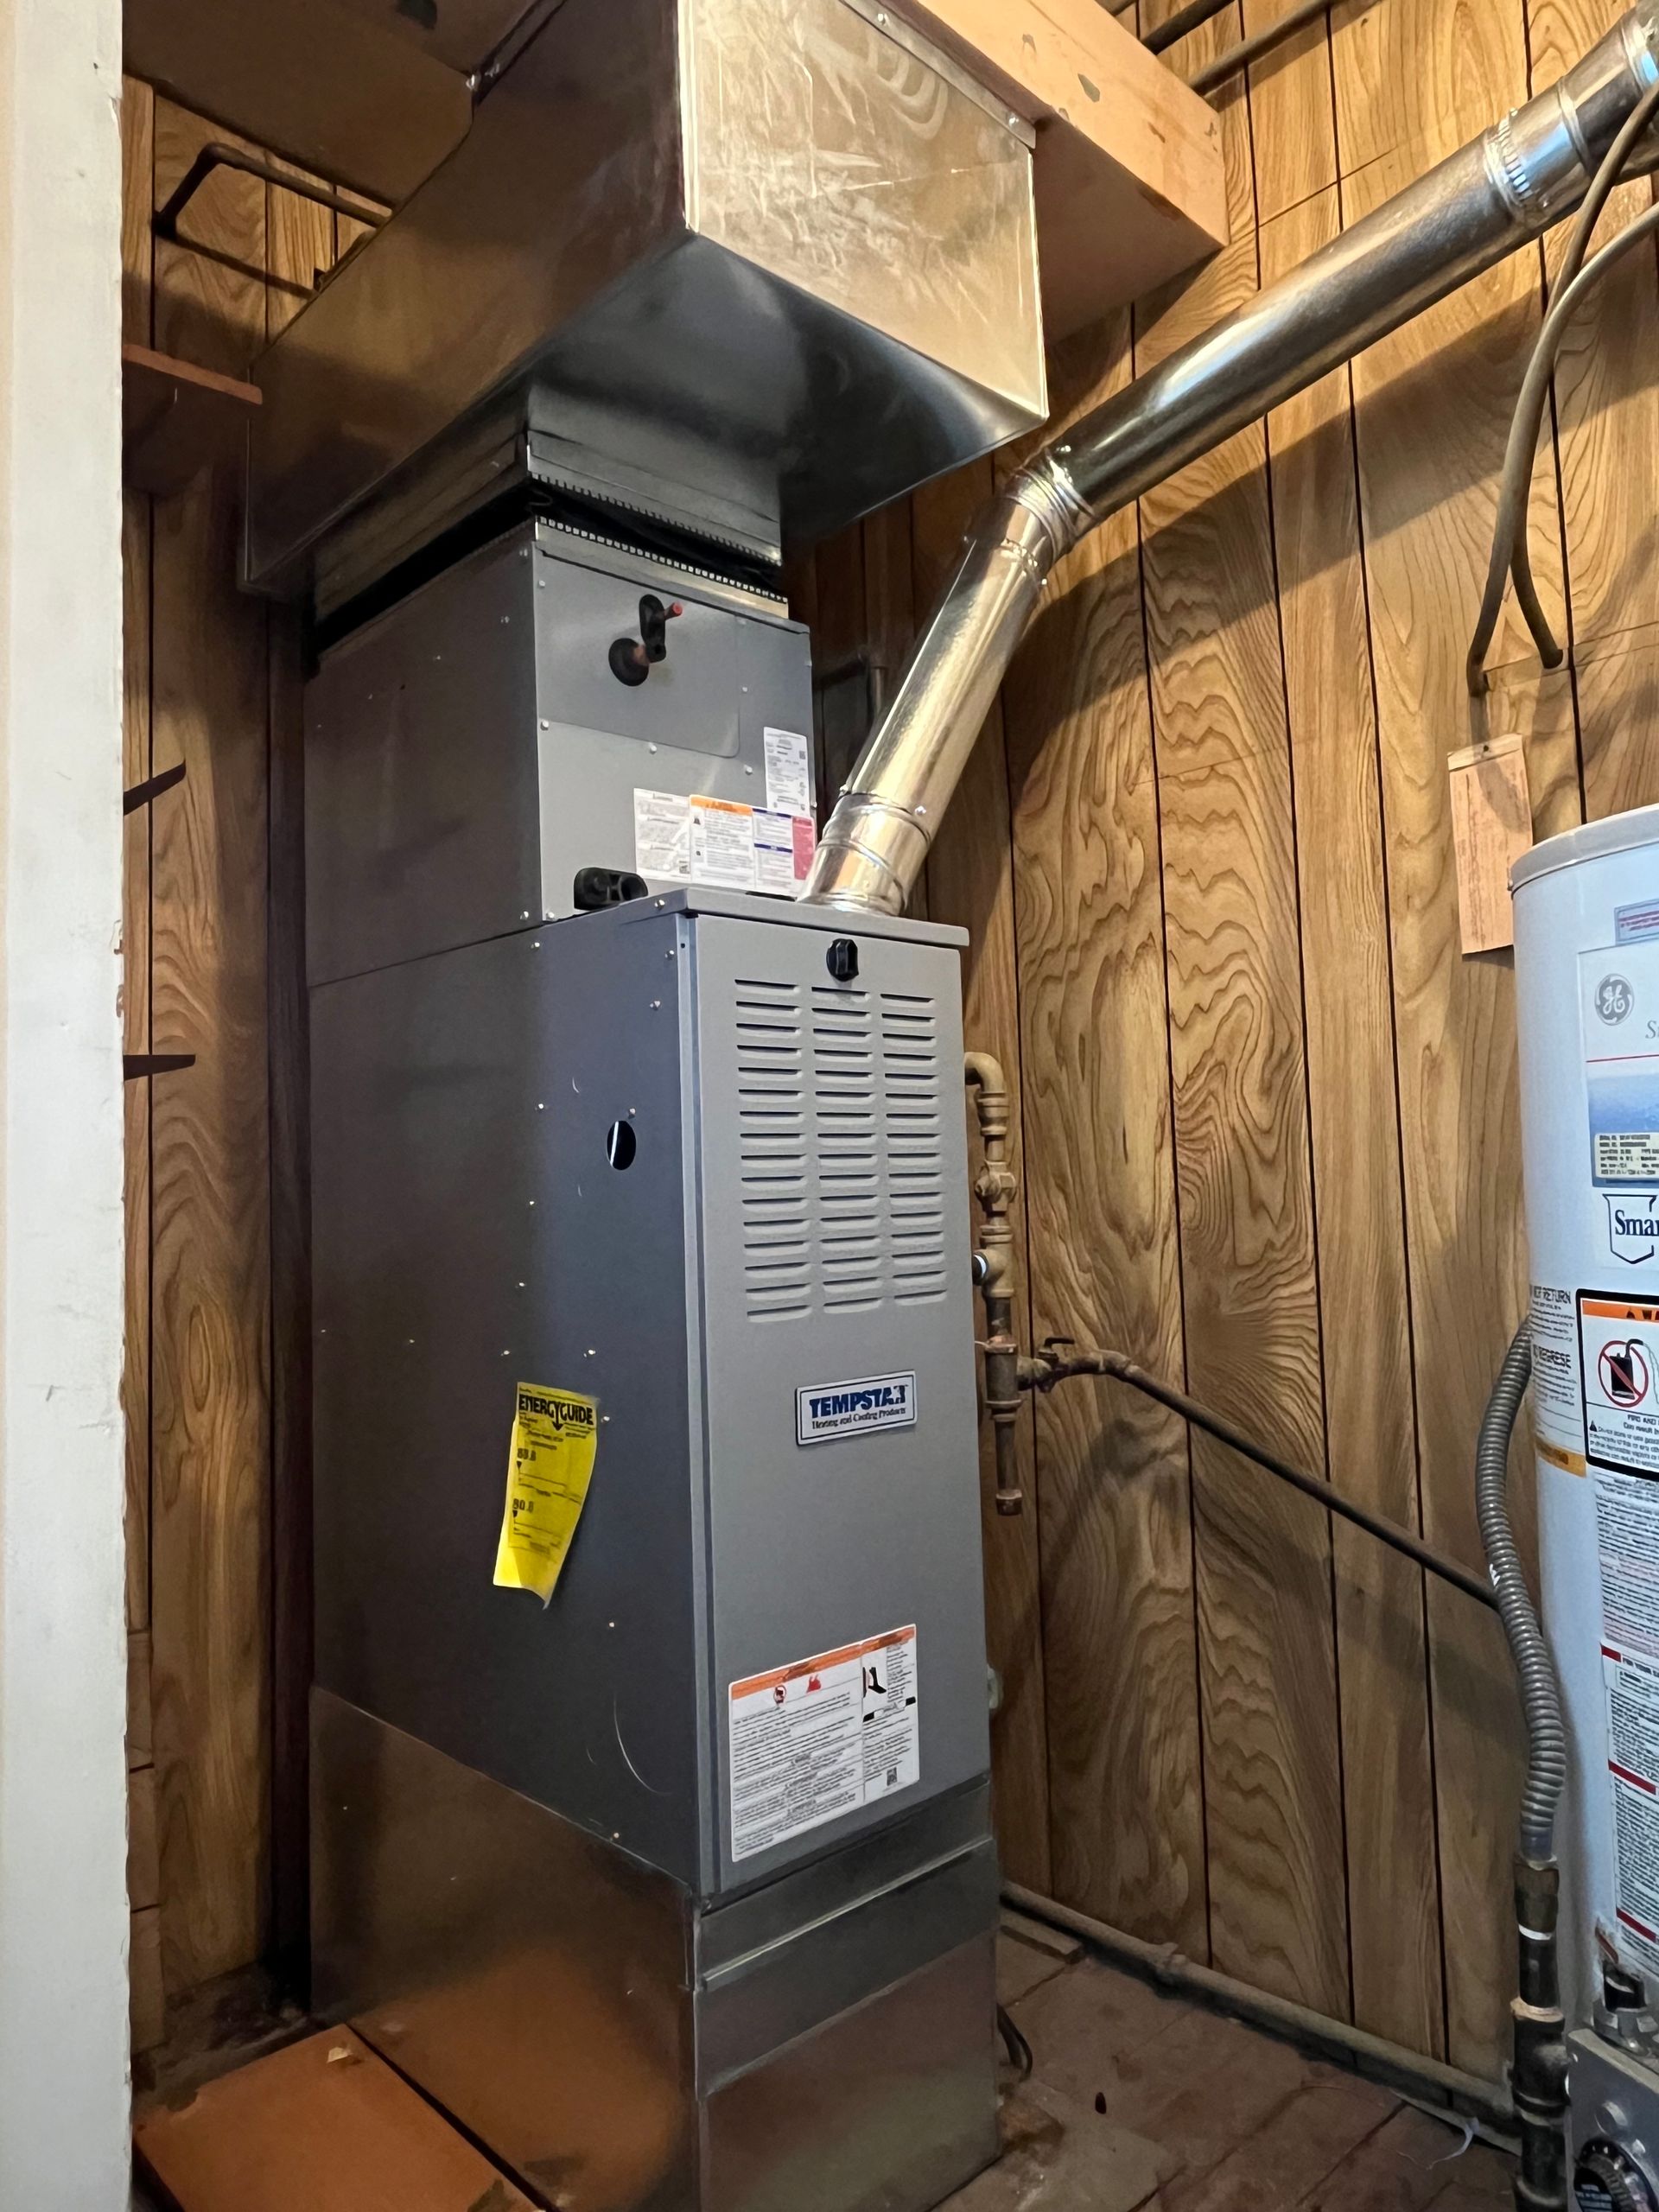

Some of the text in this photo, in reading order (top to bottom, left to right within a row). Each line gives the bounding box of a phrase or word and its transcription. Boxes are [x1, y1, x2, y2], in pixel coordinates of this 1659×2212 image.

[810, 1384, 906, 1419] TEMPSTAR
[840, 1414, 852, 1425] and
[879, 1406, 906, 1420] Products
